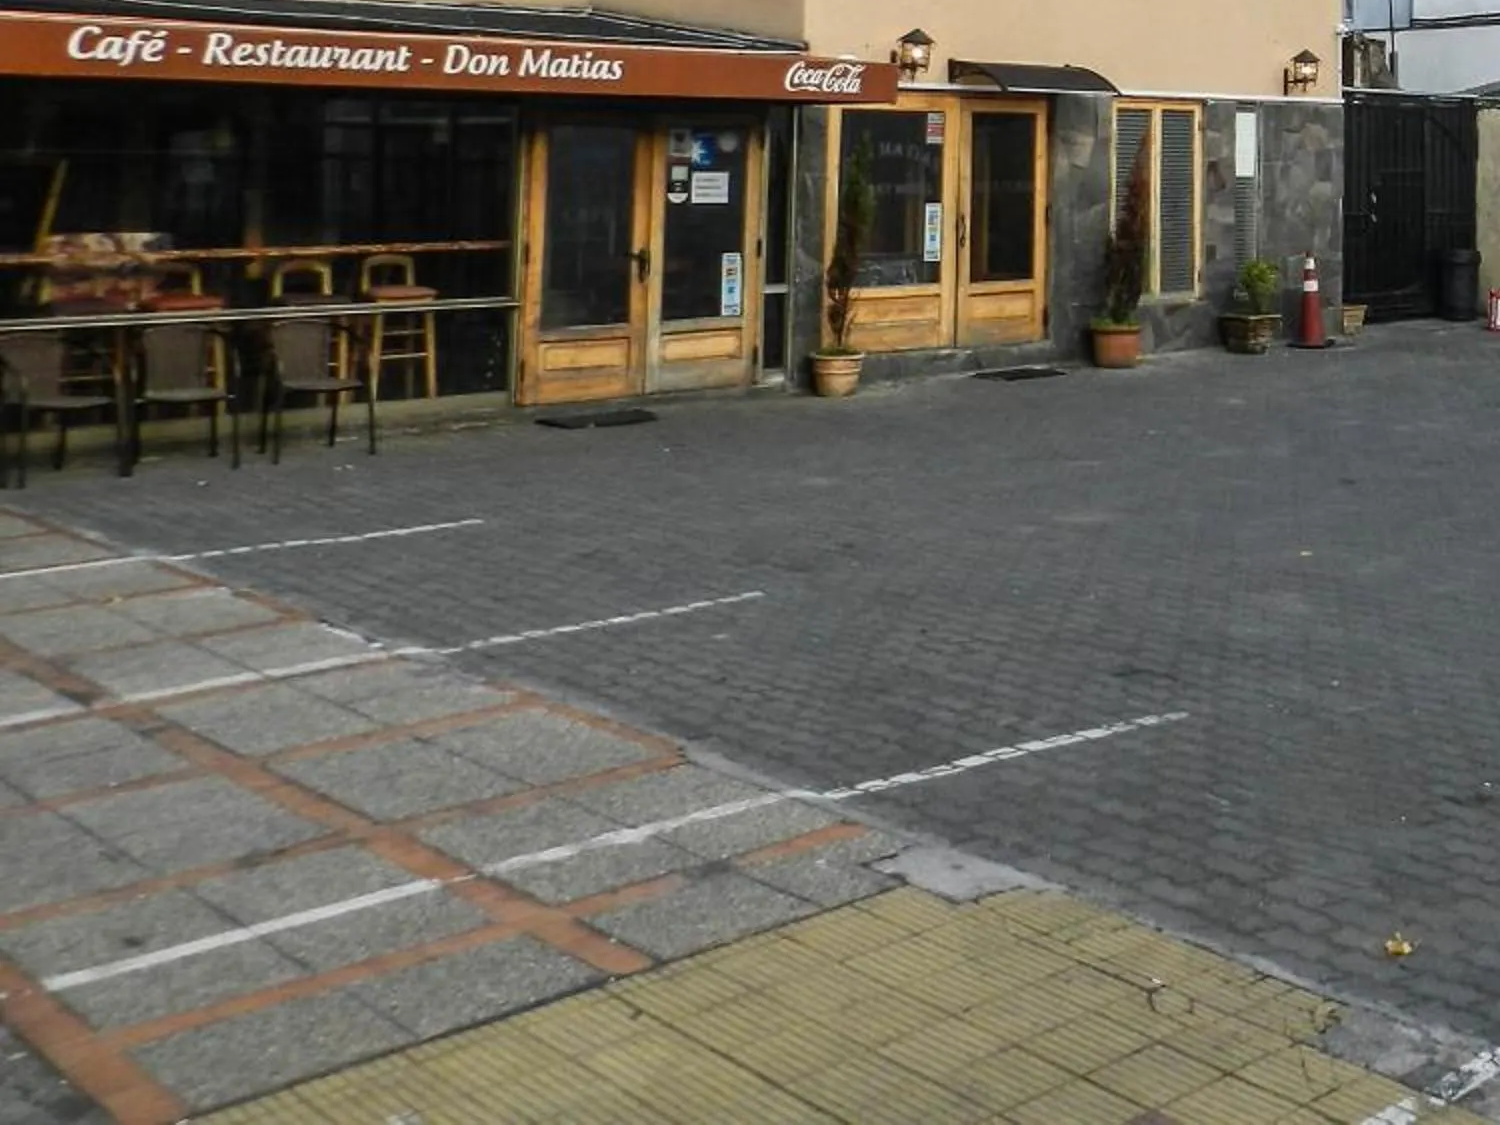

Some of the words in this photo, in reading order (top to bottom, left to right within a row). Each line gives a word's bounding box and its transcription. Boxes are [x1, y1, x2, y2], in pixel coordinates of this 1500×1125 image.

[67, 25, 168, 66] Café
[203, 32, 412, 74] Restaurant
[443, 44, 511, 75] Don
[517, 48, 624, 80] Matias
